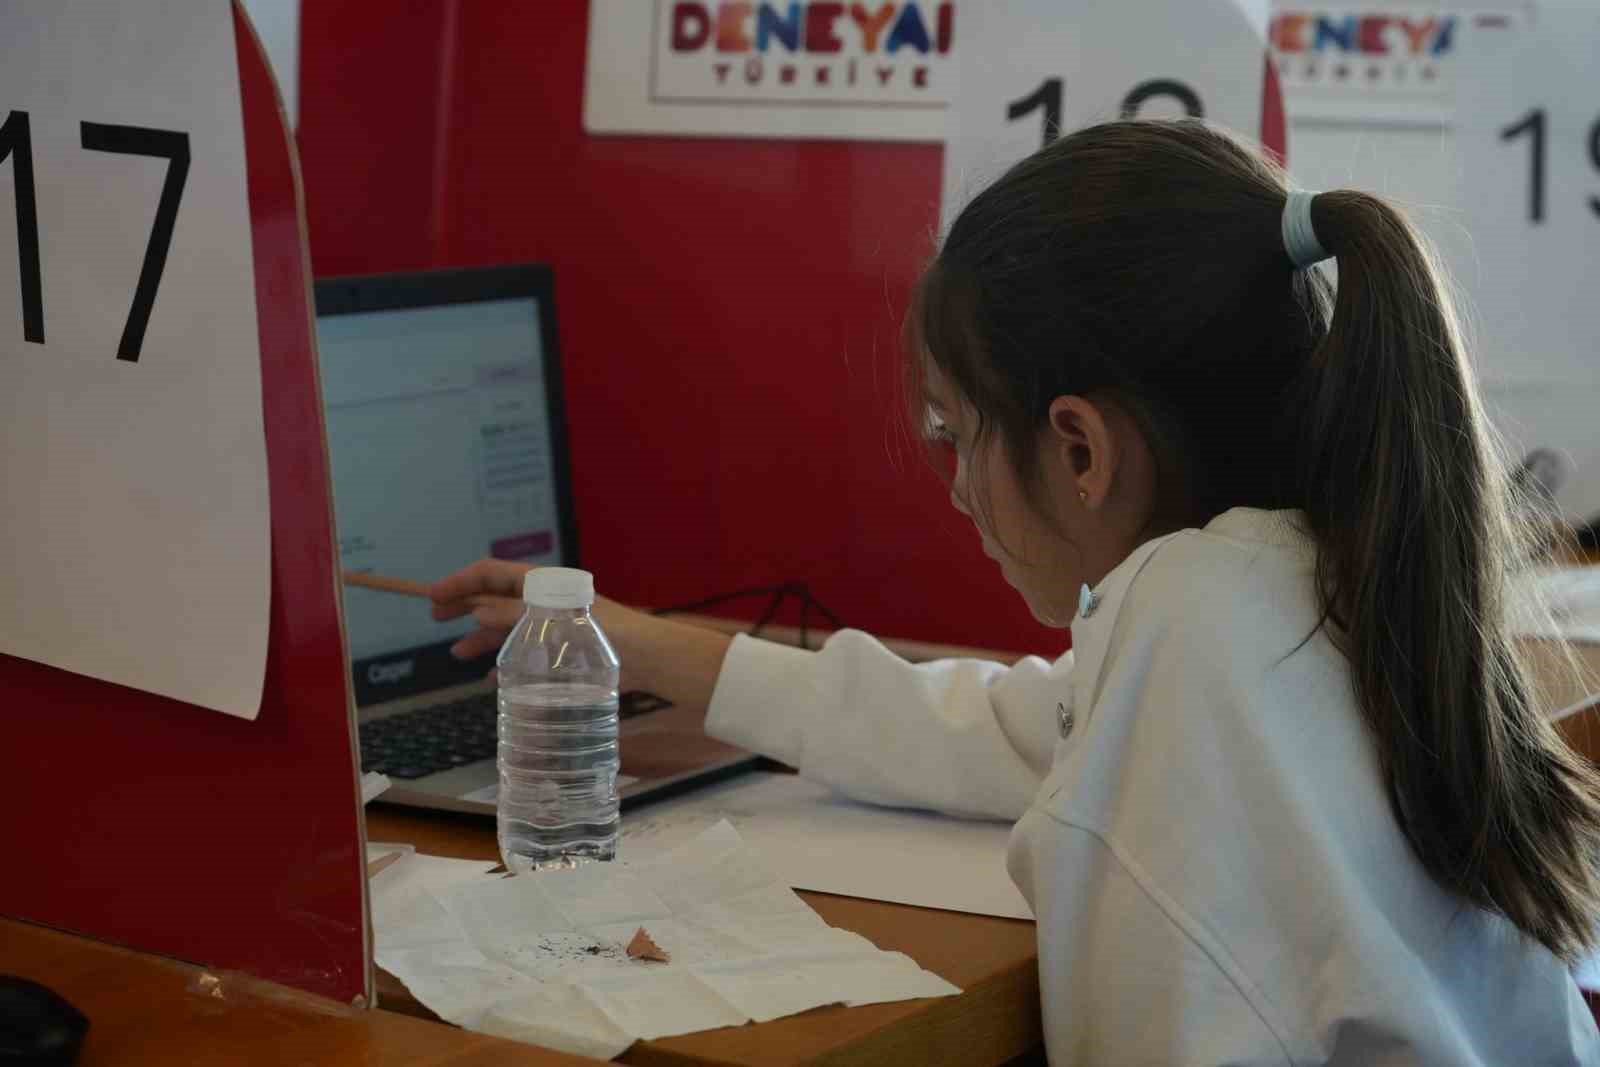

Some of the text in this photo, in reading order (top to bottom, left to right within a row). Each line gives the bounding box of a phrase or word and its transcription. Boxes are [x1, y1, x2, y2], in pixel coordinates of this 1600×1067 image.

[713, 59, 929, 87] TÜRKİYE
[1499, 107, 1600, 225] 1
[0, 110, 191, 363] 17
